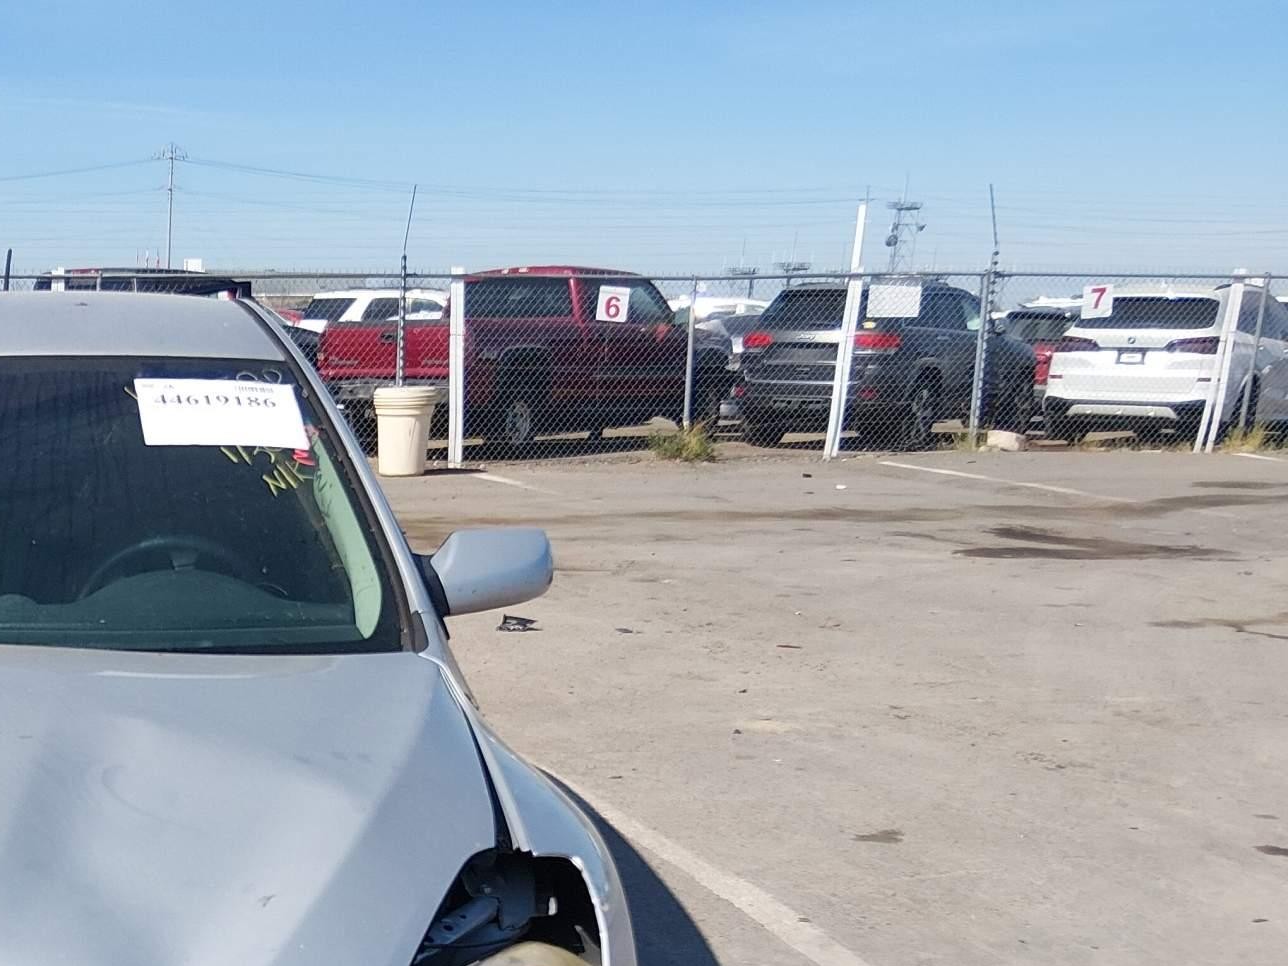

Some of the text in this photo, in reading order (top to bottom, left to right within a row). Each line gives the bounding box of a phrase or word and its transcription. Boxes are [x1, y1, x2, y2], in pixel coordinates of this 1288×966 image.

[604, 295, 621, 319] 6
[1090, 287, 1107, 309] 7
[153, 393, 277, 408] 44619186
